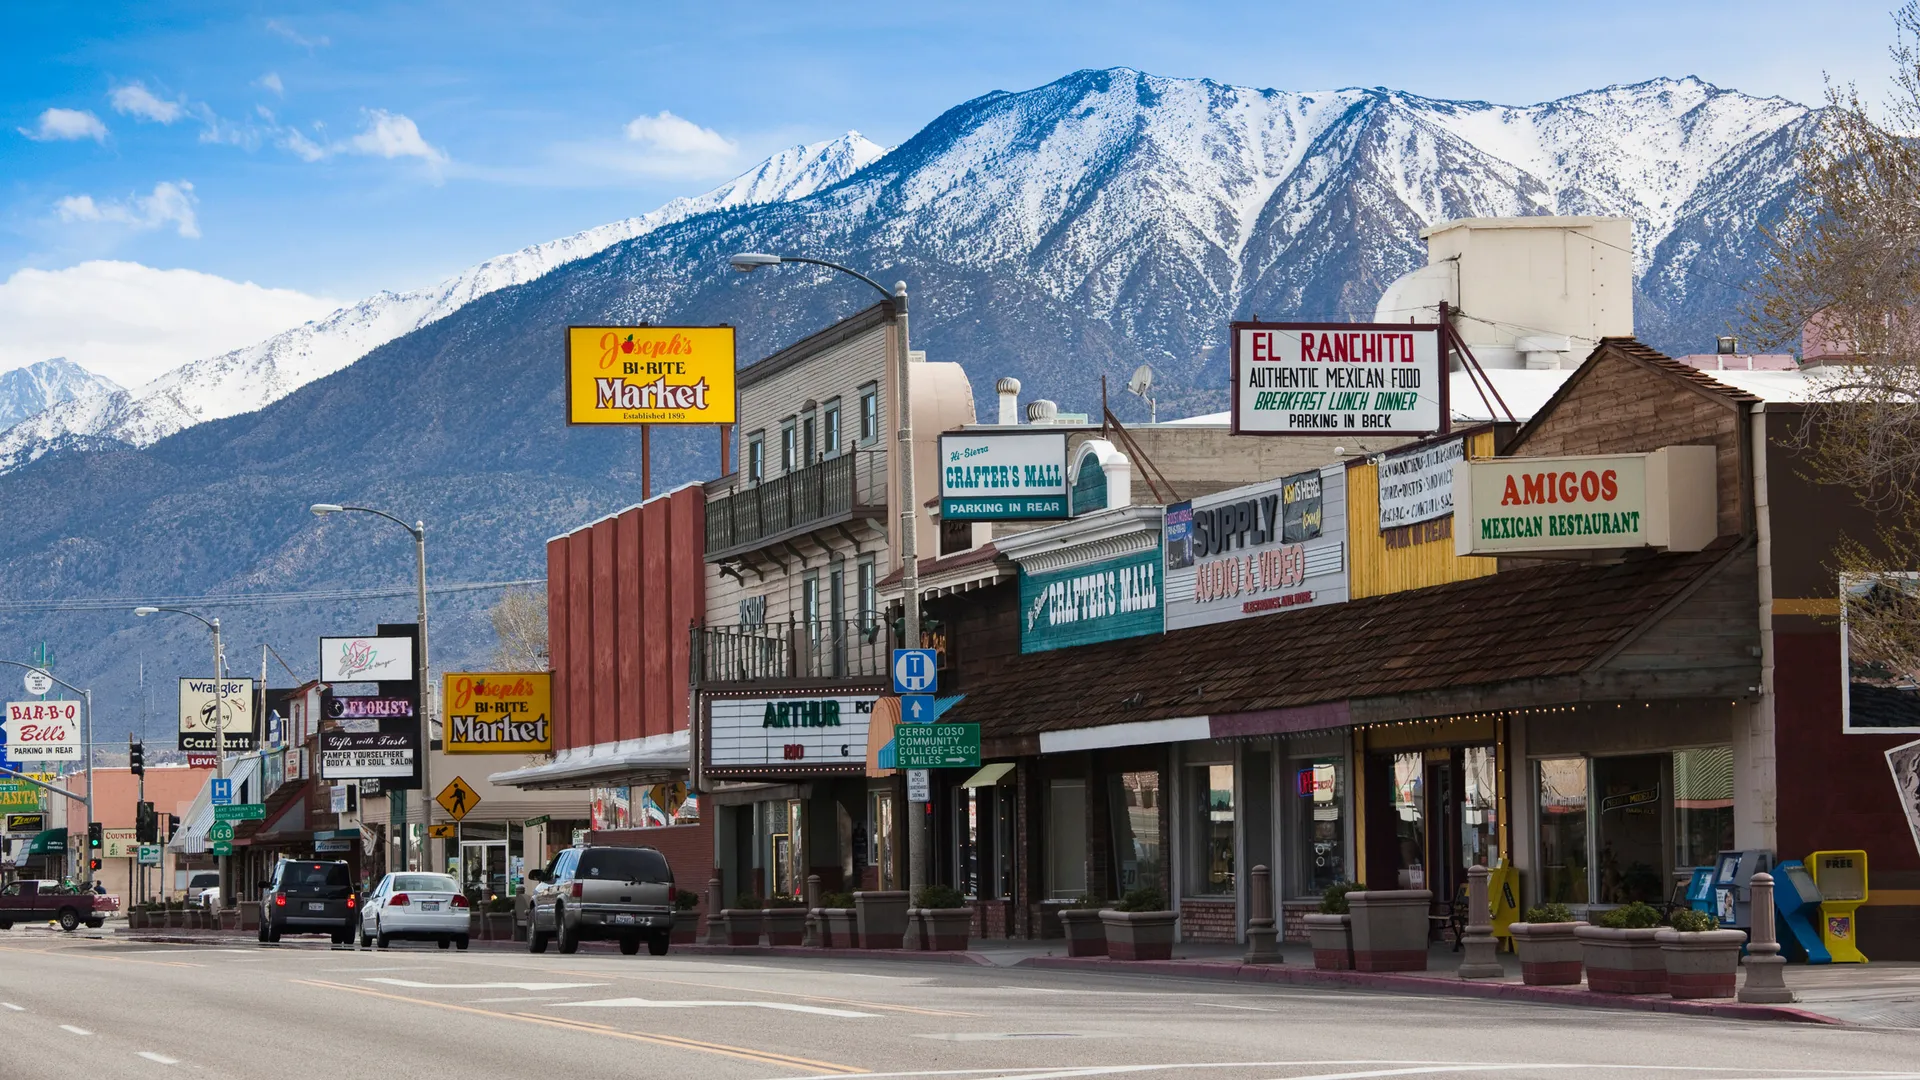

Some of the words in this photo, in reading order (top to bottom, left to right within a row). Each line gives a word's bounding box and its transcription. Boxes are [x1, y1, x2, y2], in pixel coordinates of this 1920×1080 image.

[599, 332, 693, 369] Joseph's
[1252, 332, 1281, 362] EL
[1301, 332, 1414, 363] RANCHITO
[1249, 367, 1319, 388] AUTHENTIC
[1326, 367, 1384, 388] MEXICAN
[1391, 368, 1421, 388] FOOD
[594, 374, 710, 410] Market
[1254, 391, 1326, 410] BREAKFAST
[1328, 391, 1370, 410] LUNCH
[1374, 391, 1418, 411] DINNER
[623, 412, 666, 420] Established
[668, 412, 685, 420] 1895
[1289, 414, 1338, 428] PARKING
[1344, 414, 1354, 428] IN
[1362, 414, 1392, 428] BACK
[950, 445, 989, 462] Hi-Sierra
[946, 466, 1020, 488] CRAFTER'S
[1024, 464, 1062, 487] MALL
[1501, 470, 1618, 506] AMIGOS
[950, 503, 1004, 514] PARKING
[1009, 503, 1021, 512] IN
[1027, 502, 1060, 512] REAR
[1193, 494, 1278, 557] SUPPLY
[1481, 516, 1543, 539] MEXICAN
[1549, 511, 1640, 536] RESTAURANT
[1194, 556, 1240, 604] AUDIO
[1244, 554, 1256, 595] &
[1257, 543, 1305, 592] VIDEO
[1049, 571, 1116, 626] CRAFTER'S
[1119, 563, 1157, 613] MALL
[455, 677, 535, 709] Joseph's
[11, 705, 76, 720] BAR-B-Q
[349, 700, 409, 714] FLORIST
[763, 700, 840, 728] ARTHUR
[20, 724, 65, 741] Bill's
[450, 713, 549, 744] Market
[899, 727, 932, 737] CERRO
[937, 727, 964, 736] COSO
[329, 736, 353, 750] Gifts
[356, 735, 373, 745] with
[378, 736, 408, 745] Taste
[899, 737, 960, 746] COMMUNITY
[323, 751, 350, 759] PAMPER
[784, 744, 804, 760] RIO
[841, 744, 848, 757] G
[899, 746, 977, 756] COLLEGE-ESCC
[326, 759, 342, 767] BODY
[368, 758, 385, 766] SOUL
[391, 758, 414, 766] SALON
[899, 756, 906, 765] 5
[911, 756, 941, 765] MILES
[215, 781, 227, 796] H
[11, 816, 40, 827] ZENITH
[213, 829, 231, 839] 168
[1825, 859, 1853, 868] FREE
